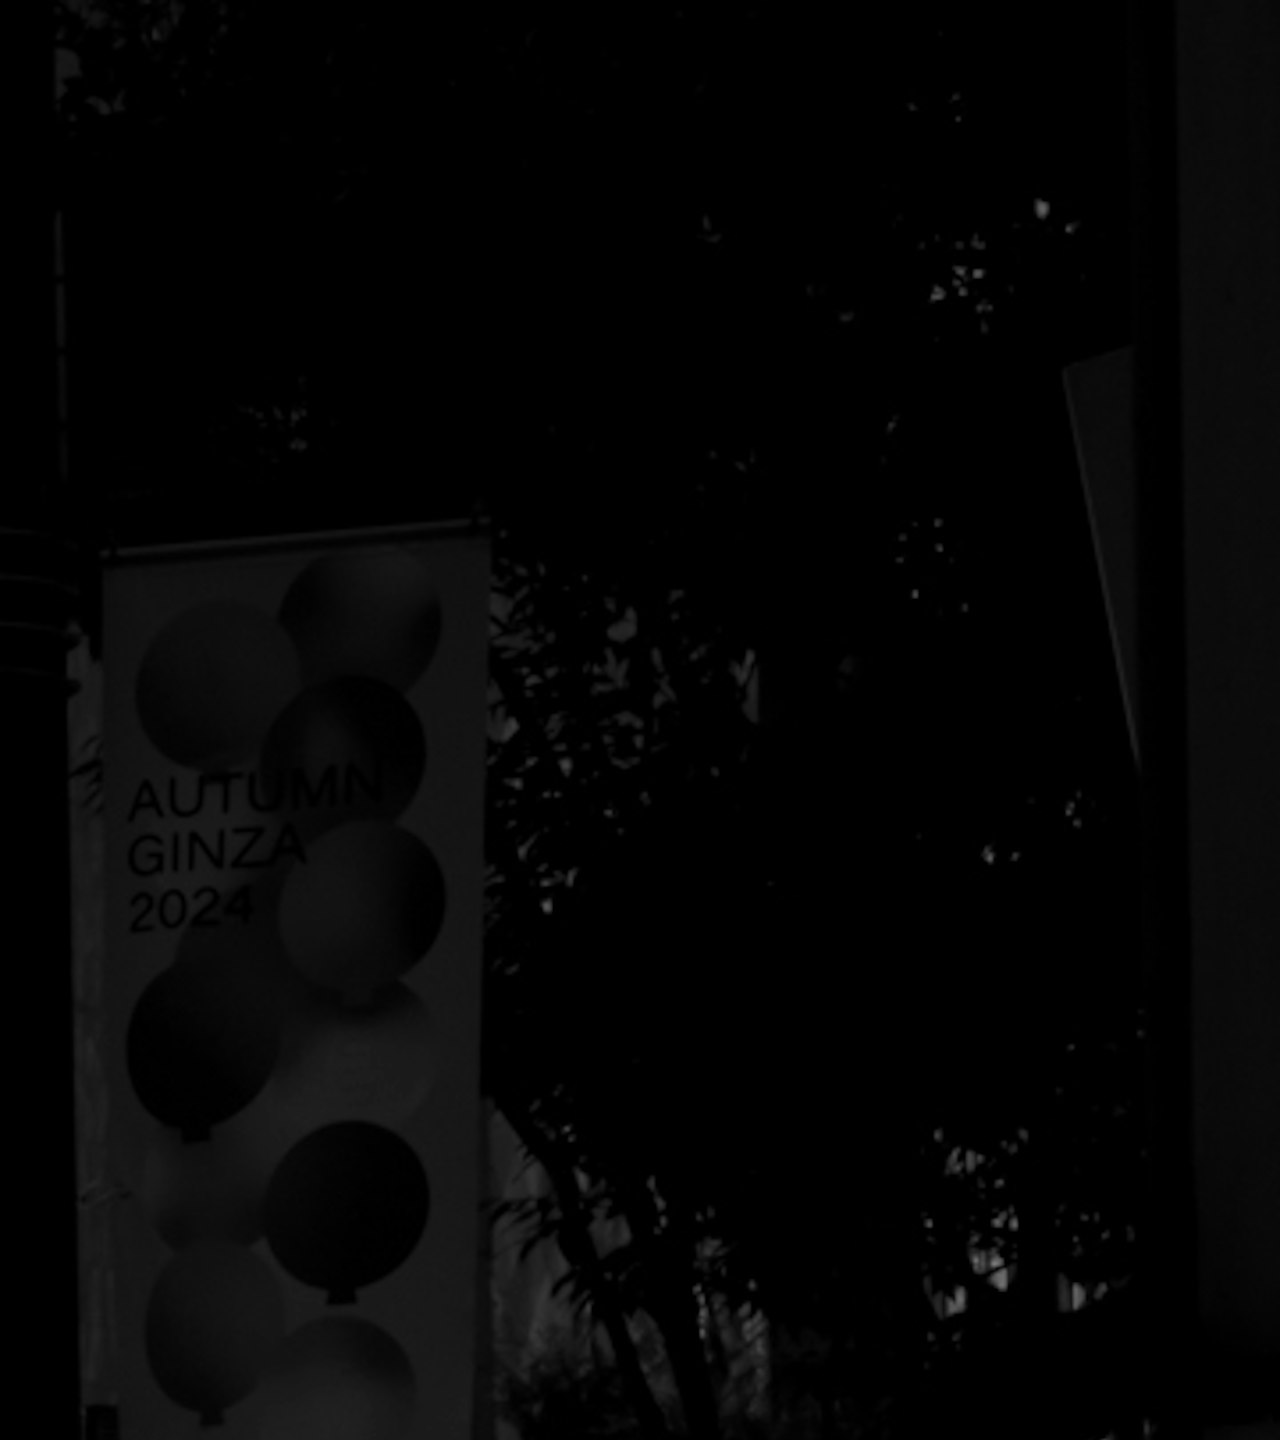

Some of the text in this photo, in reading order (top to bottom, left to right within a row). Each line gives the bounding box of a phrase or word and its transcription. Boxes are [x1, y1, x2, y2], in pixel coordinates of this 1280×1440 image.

[128, 764, 383, 822] AUTUMN
[129, 822, 307, 876] GINZA
[130, 886, 252, 933] 2024
